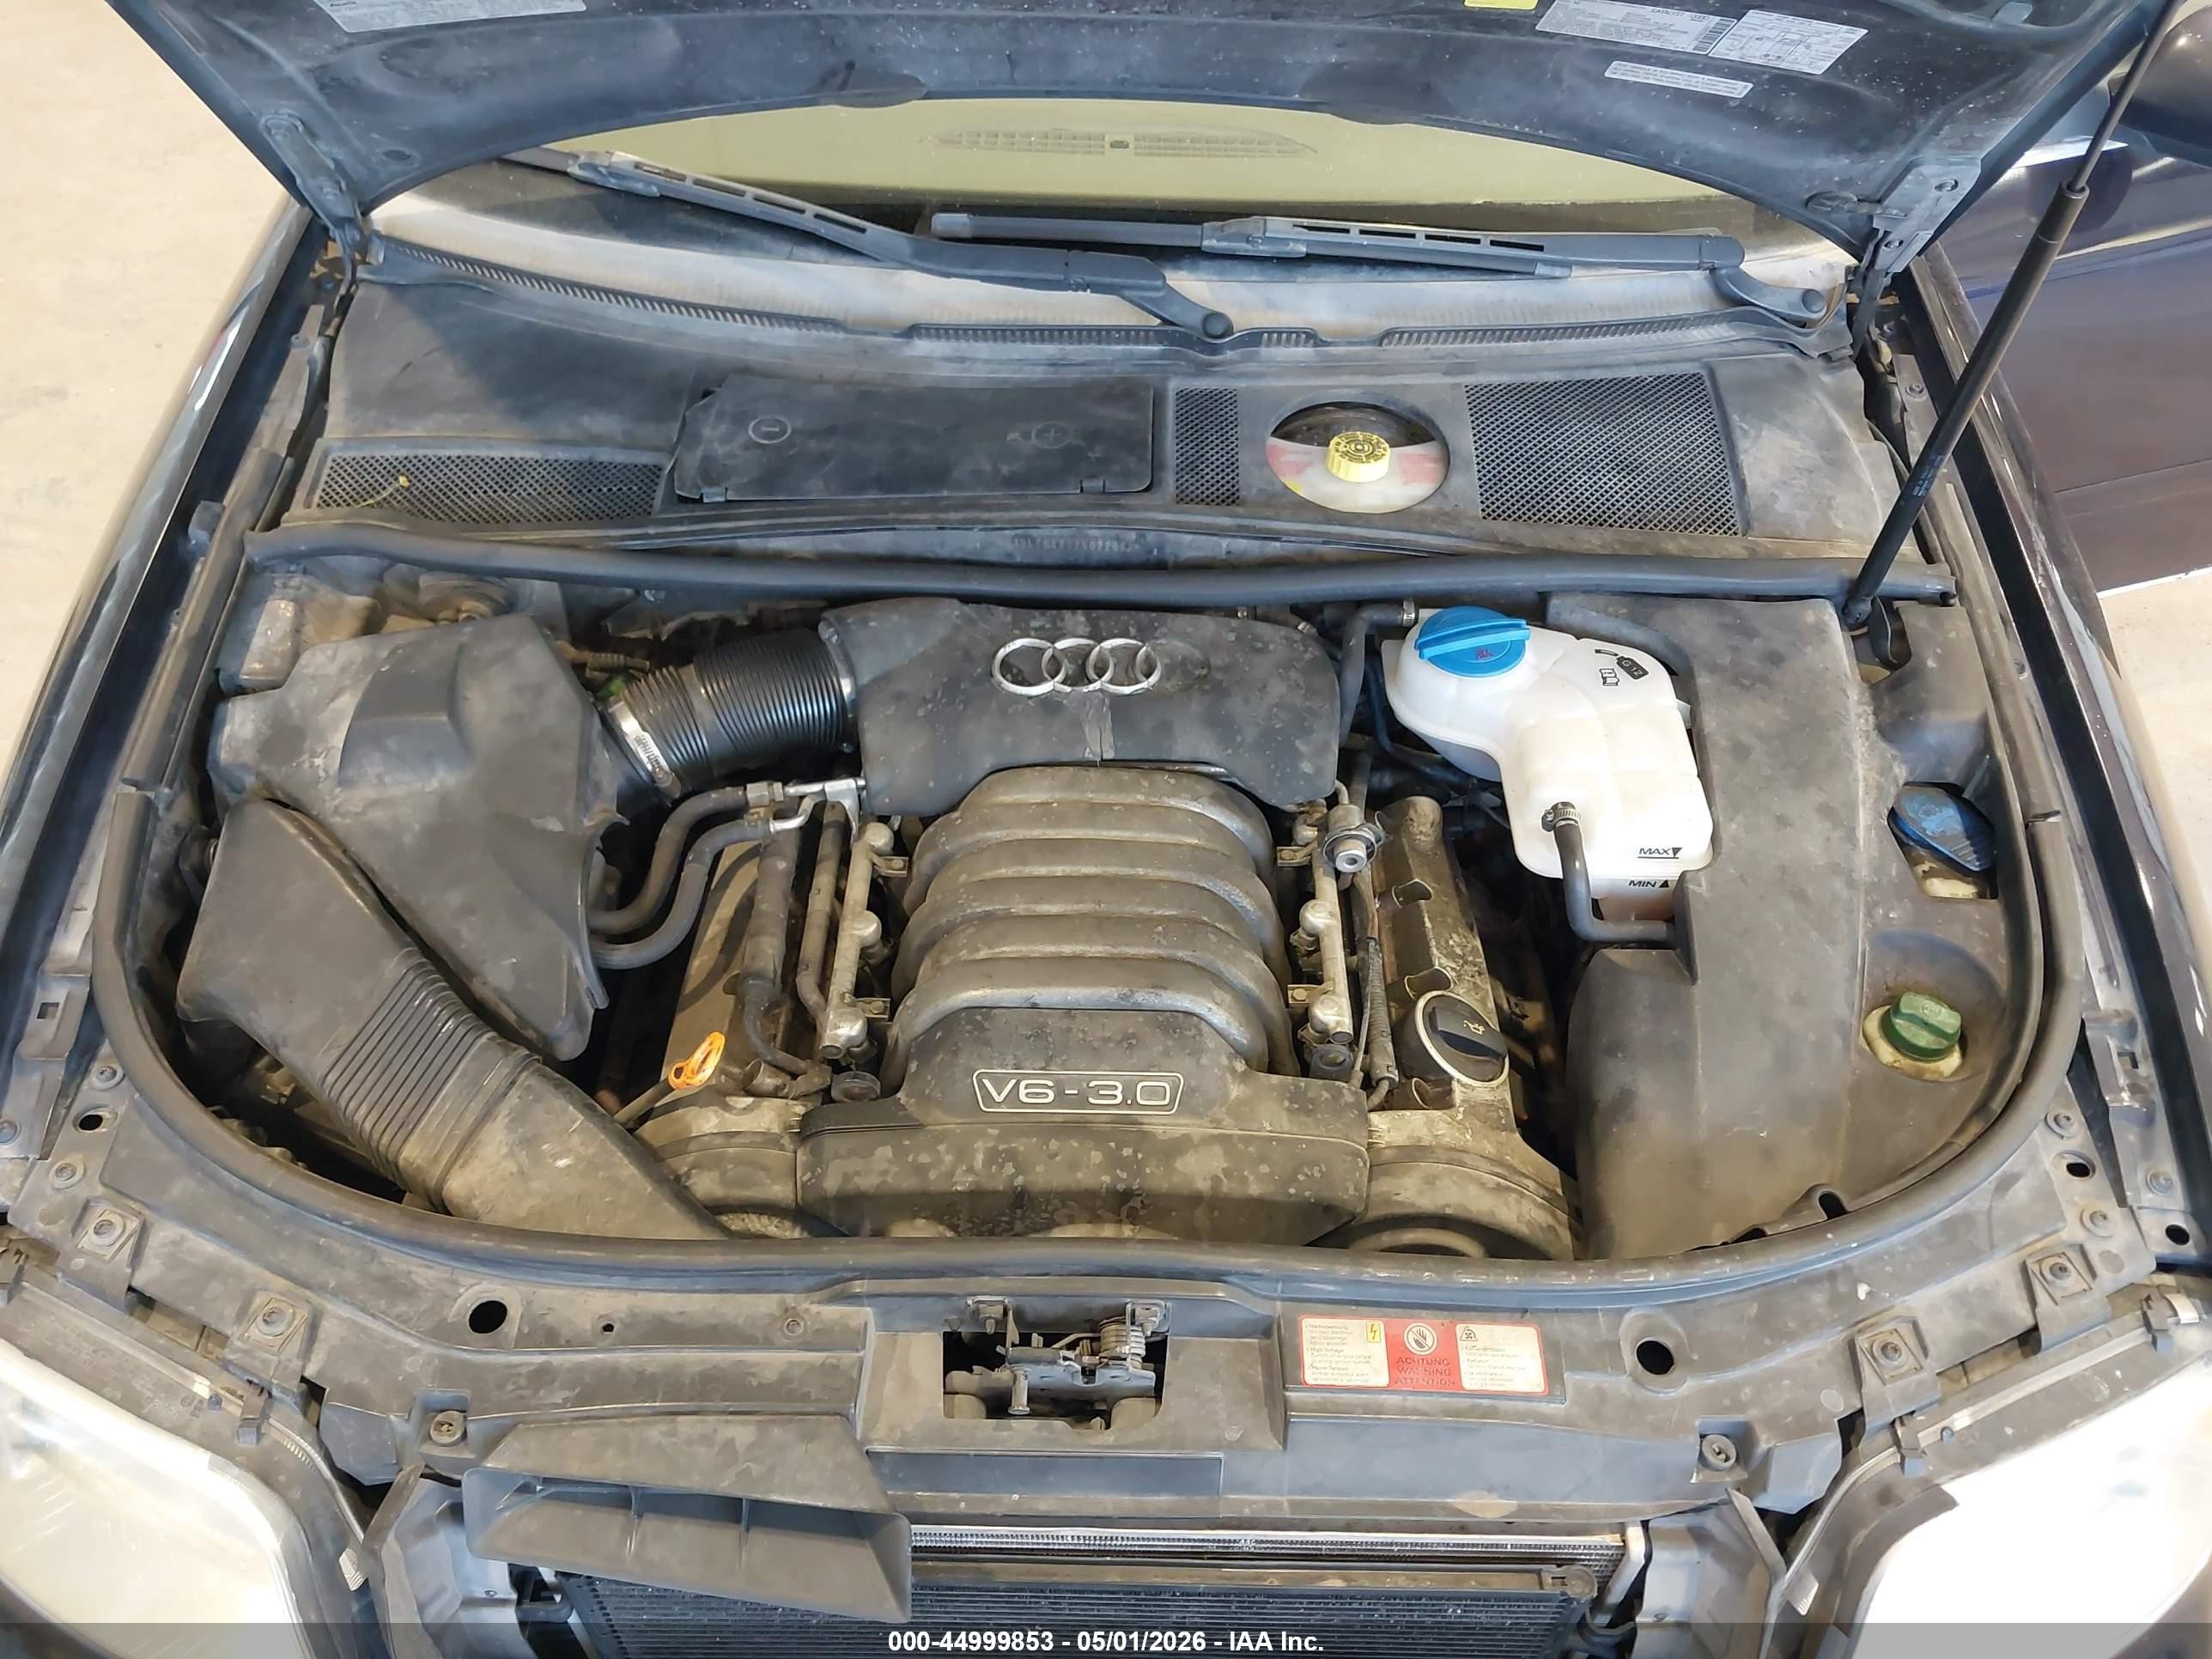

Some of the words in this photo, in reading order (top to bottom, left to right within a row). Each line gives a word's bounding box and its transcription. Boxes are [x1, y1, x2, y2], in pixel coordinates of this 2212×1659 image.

[1632, 666, 1644, 677] 12
[1638, 848, 1671, 856] MAX
[1628, 879, 1657, 888] MIN
